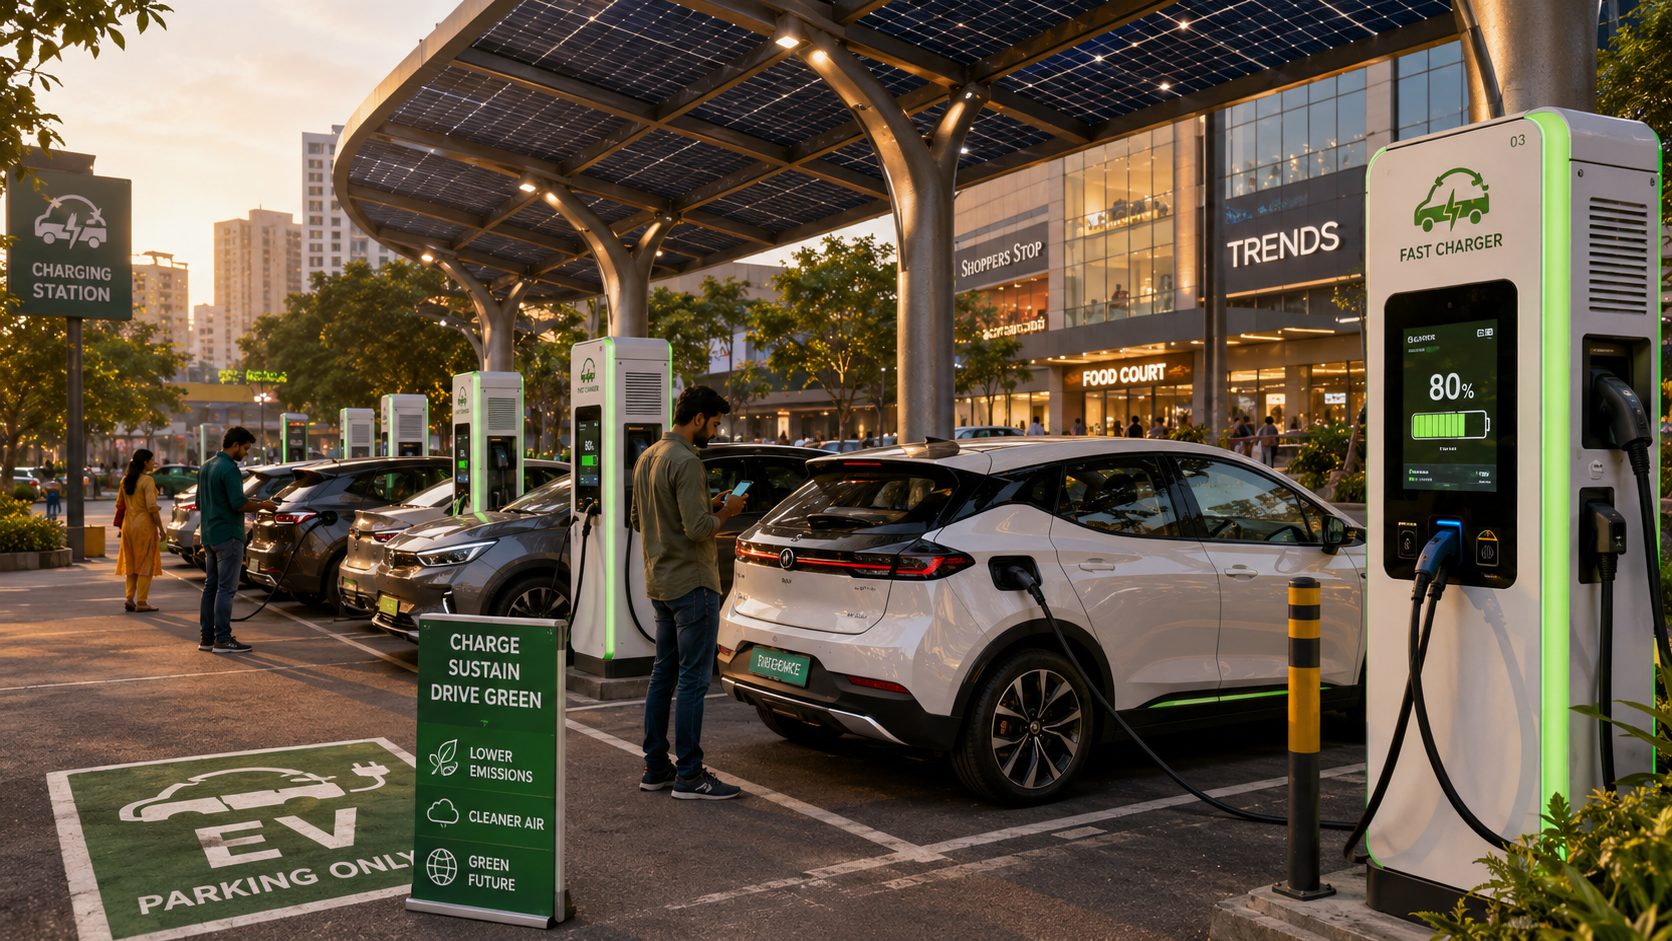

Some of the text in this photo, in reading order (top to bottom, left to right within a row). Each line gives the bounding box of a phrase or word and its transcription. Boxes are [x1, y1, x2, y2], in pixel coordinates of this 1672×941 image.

[1510, 134, 1526, 148] 03
[1226, 220, 1341, 268] TRENDS
[1400, 233, 1503, 263] FAST CHARGER
[32, 262, 112, 281] CHARGING
[32, 283, 111, 302] STATION
[1082, 362, 1167, 387] FOOD COURT
[1429, 372, 1475, 401] 80%
[450, 633, 520, 654] CHARGE
[448, 659, 520, 681] SUSTAIN
[431, 683, 542, 709] DRIVE GREEN
[469, 746, 513, 763] LOWER
[469, 765, 533, 783] EMISSIONS
[468, 810, 545, 830] CLEANER AIR
[194, 807, 357, 869] EV
[468, 855, 510, 872] GREEN
[137, 849, 415, 915] PARKING ONLY
[468, 873, 516, 892] FUTURE
